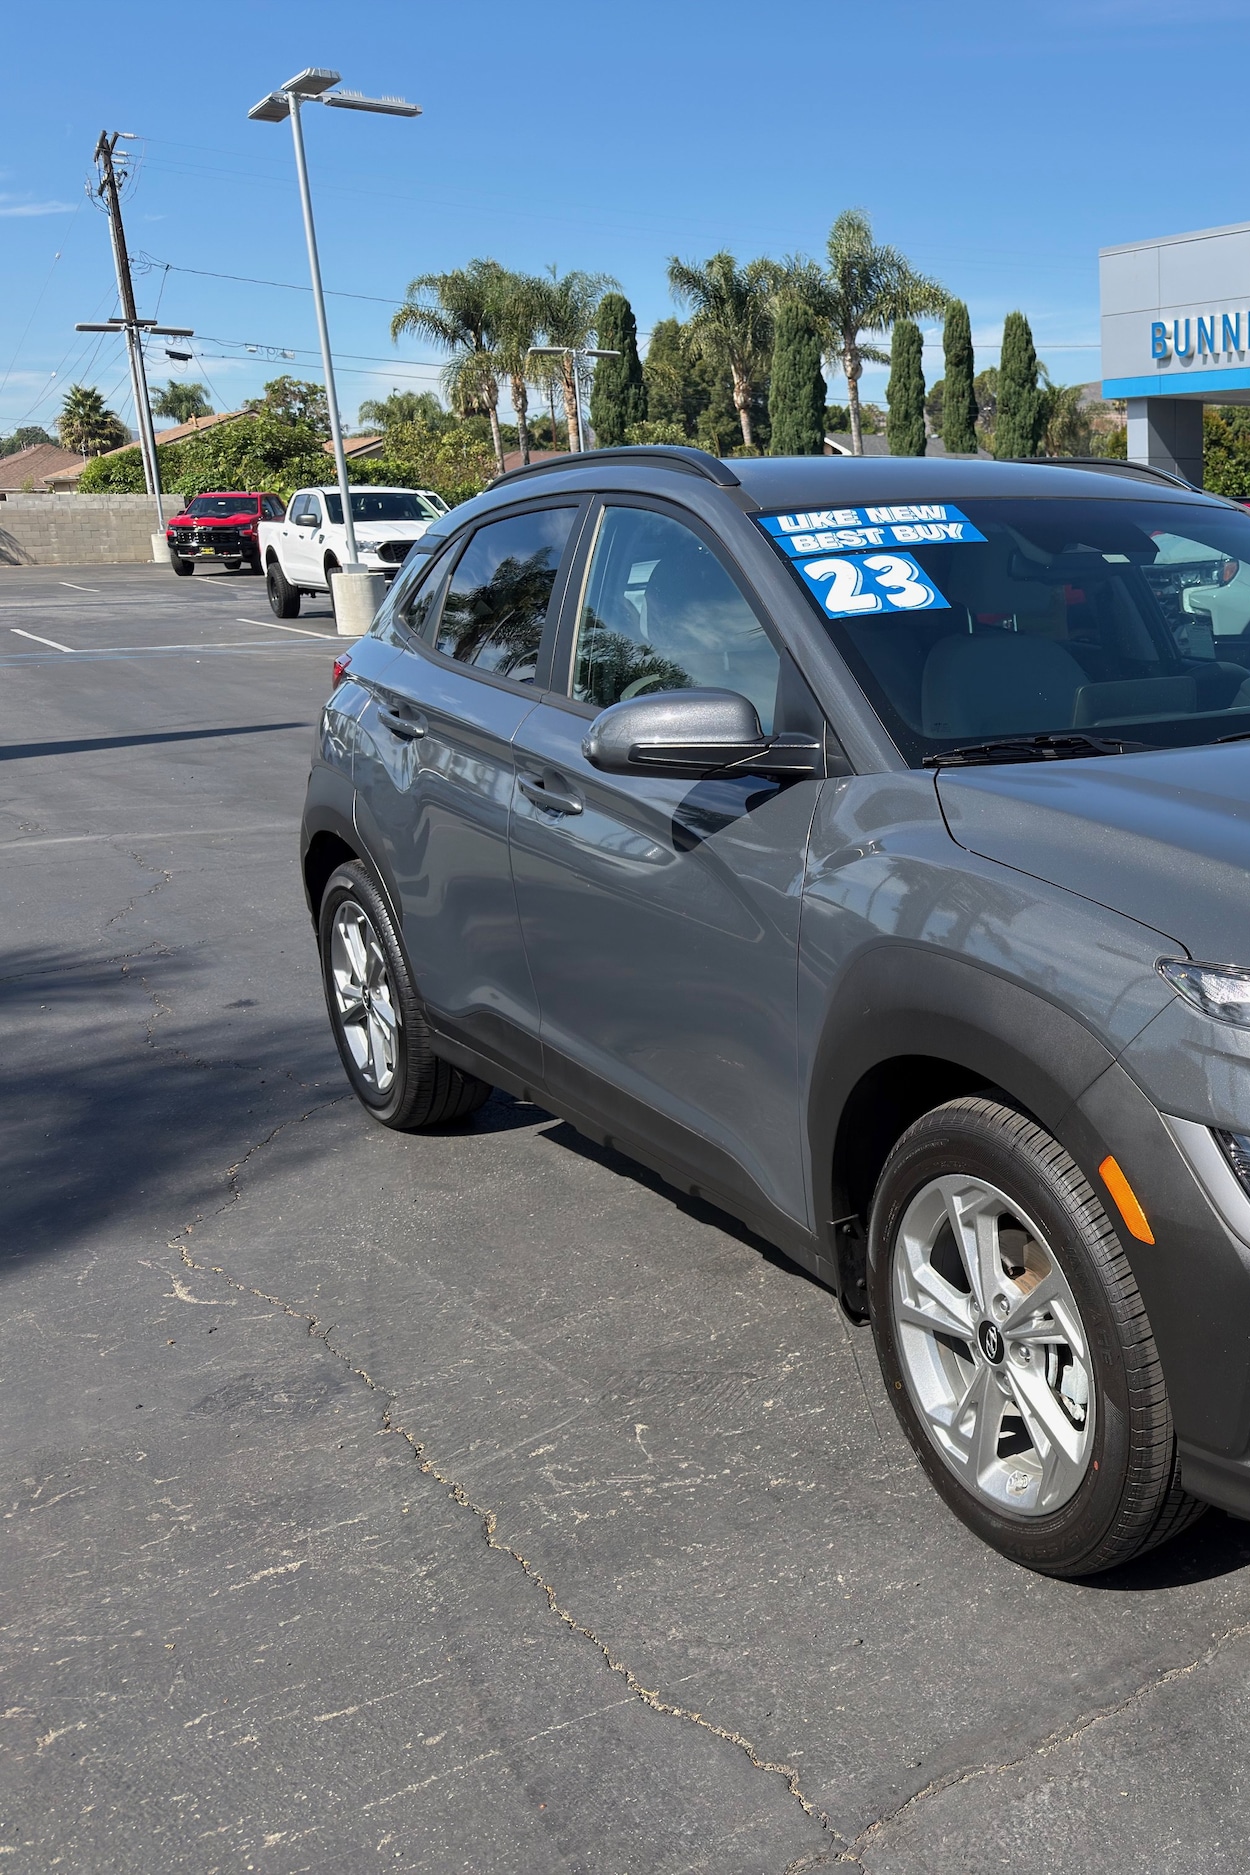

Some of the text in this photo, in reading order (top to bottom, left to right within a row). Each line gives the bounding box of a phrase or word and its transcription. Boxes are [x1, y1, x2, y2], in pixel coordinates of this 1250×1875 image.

[777, 504, 947, 532] LIKE NEW
[790, 523, 963, 553] BEST BUY
[803, 554, 935, 613] 23
